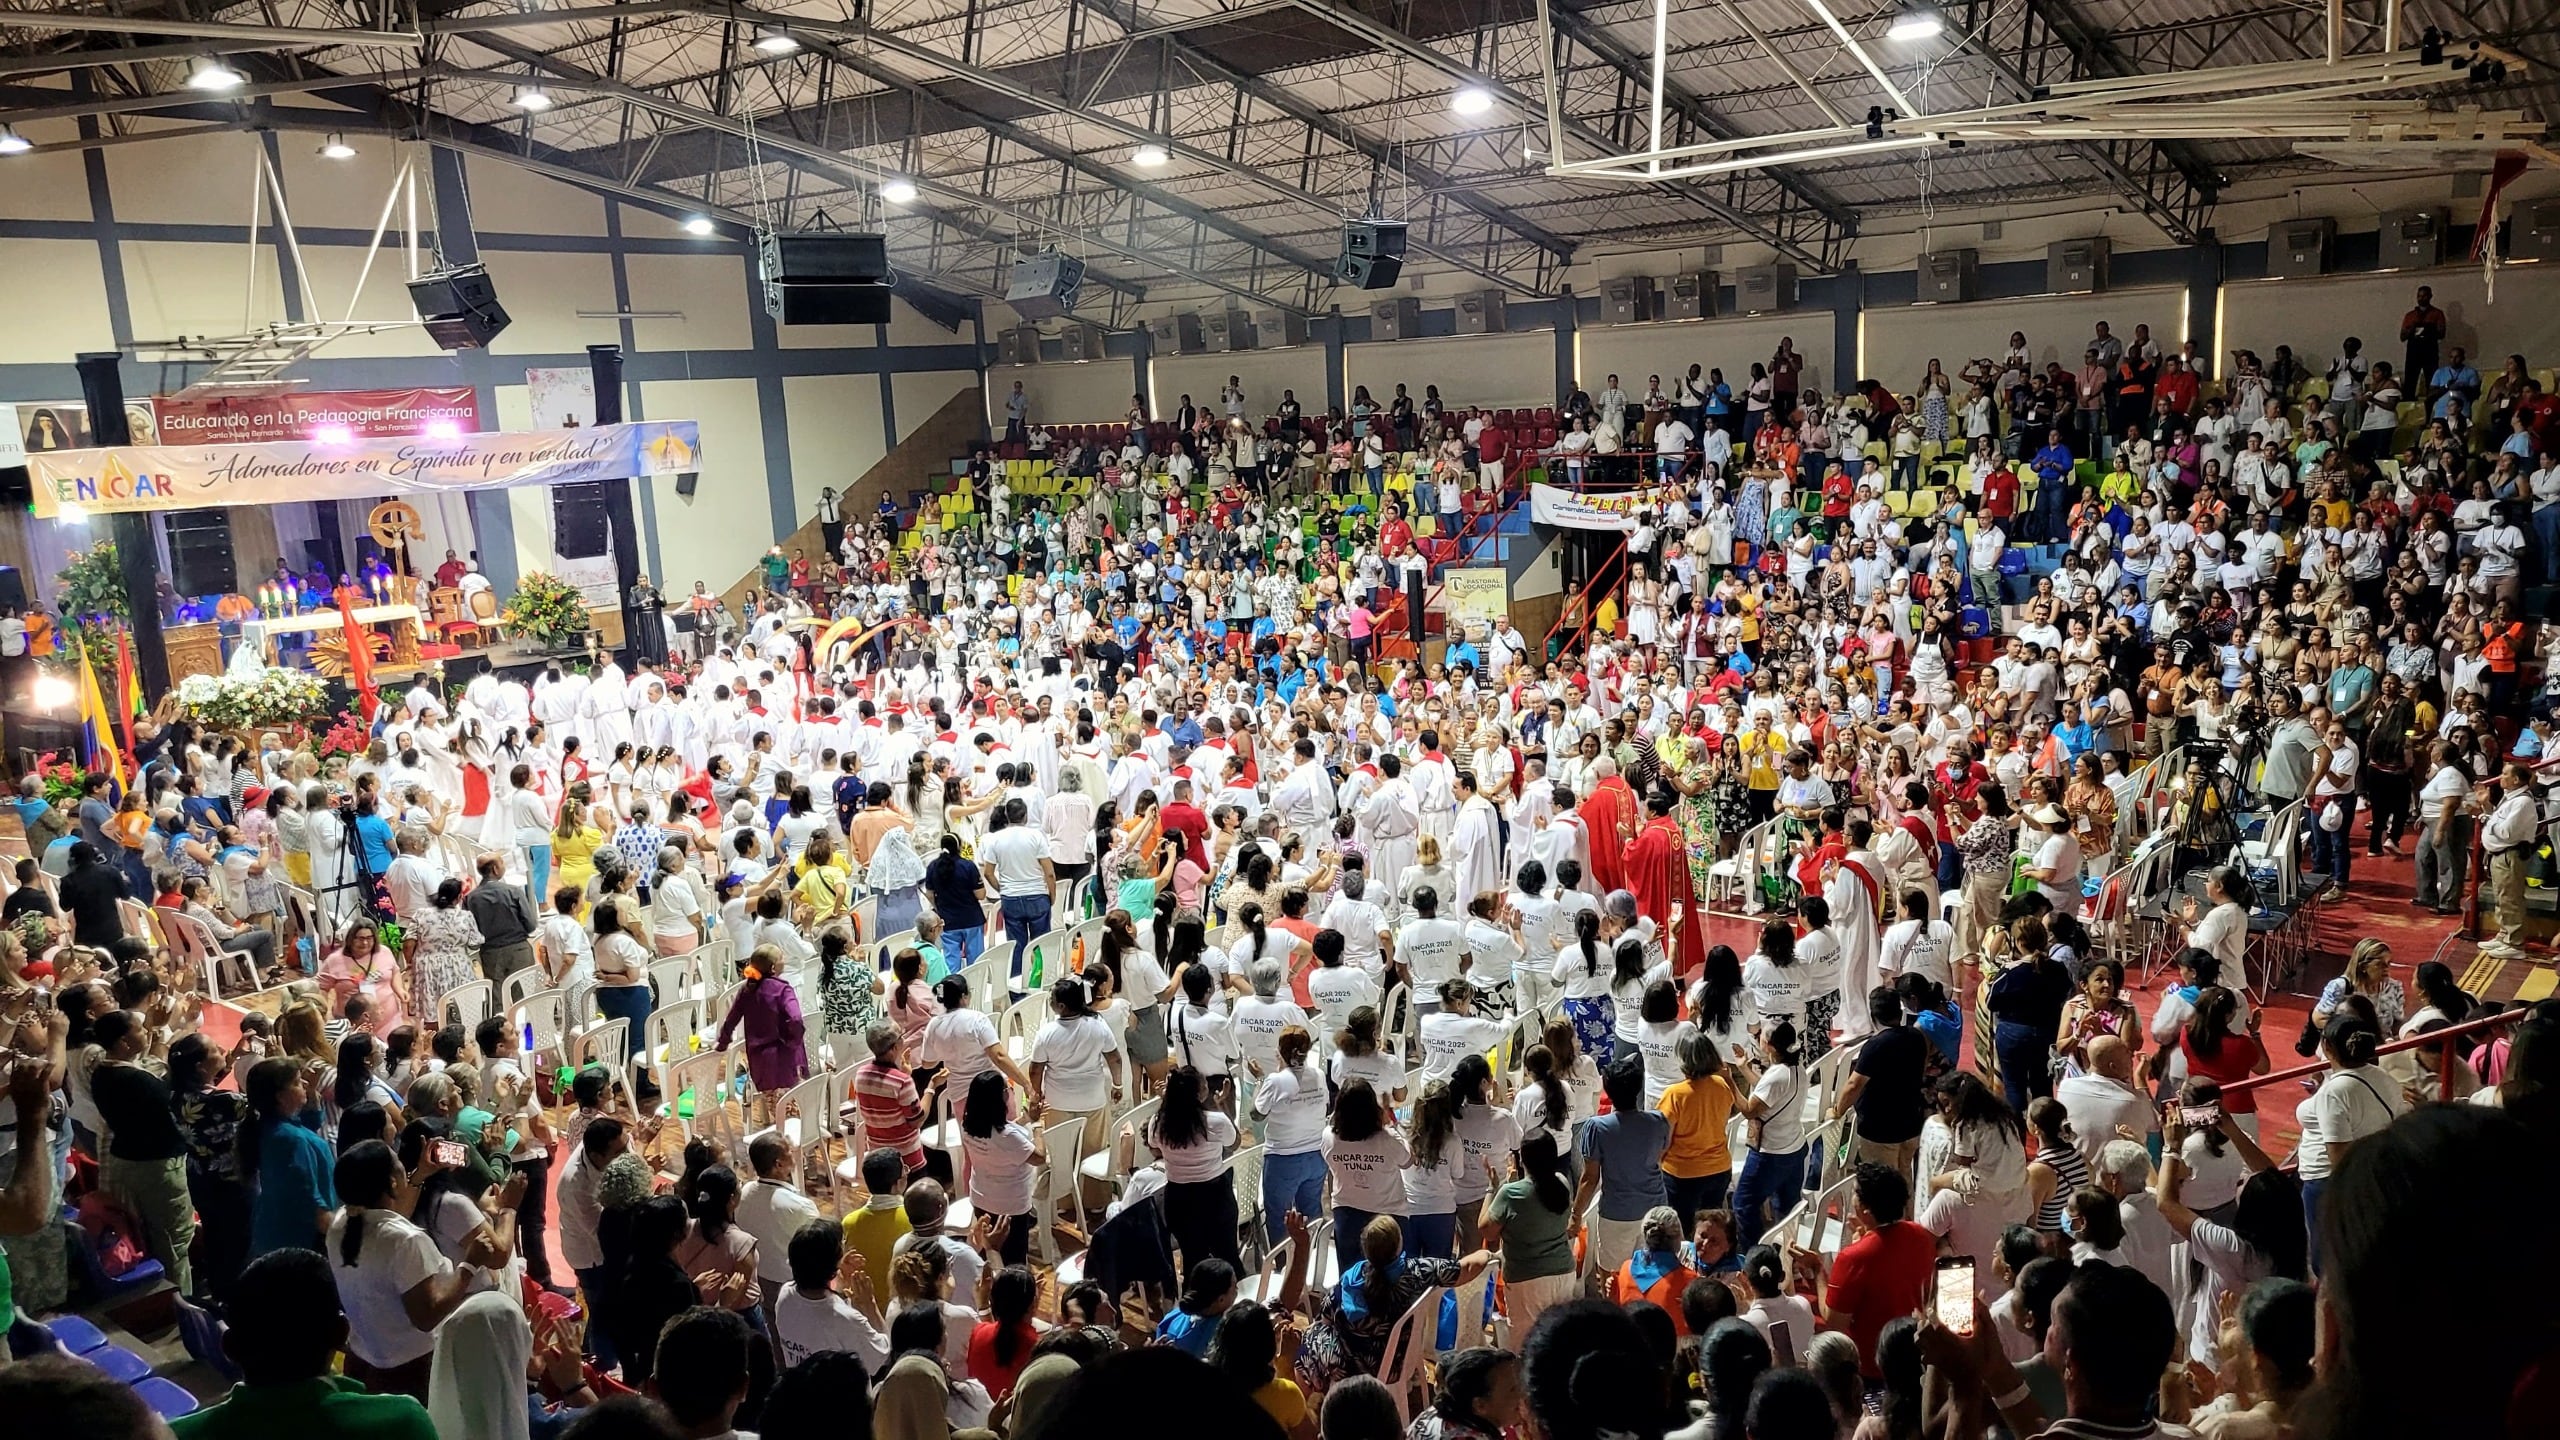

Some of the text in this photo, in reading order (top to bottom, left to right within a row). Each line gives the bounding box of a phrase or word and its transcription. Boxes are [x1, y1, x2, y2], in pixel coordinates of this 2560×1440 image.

[163, 412, 249, 430] Educando
[254, 414, 272, 426] en
[278, 410, 293, 424] la
[386, 405, 473, 421] Franciscana
[355, 459, 381, 474] en
[388, 445, 479, 482] Espíritu
[482, 453, 495, 478] y
[499, 450, 523, 464] en
[1411, 942, 1435, 952] ENCAR
[1914, 946, 1934, 954] UNJA
[1421, 947, 1444, 957] TUNJA
[1240, 1018, 1284, 1027] ENCAR 2025
[1249, 1025, 1274, 1034] TUNJA
[1661, 1044, 1673, 1052] 202
[1645, 1049, 1669, 1058] TUNJA
[1471, 1140, 1492, 1149] 2025
[1332, 1153, 1385, 1163] ENCAR 2025
[1343, 1162, 1374, 1171] TUNJA
